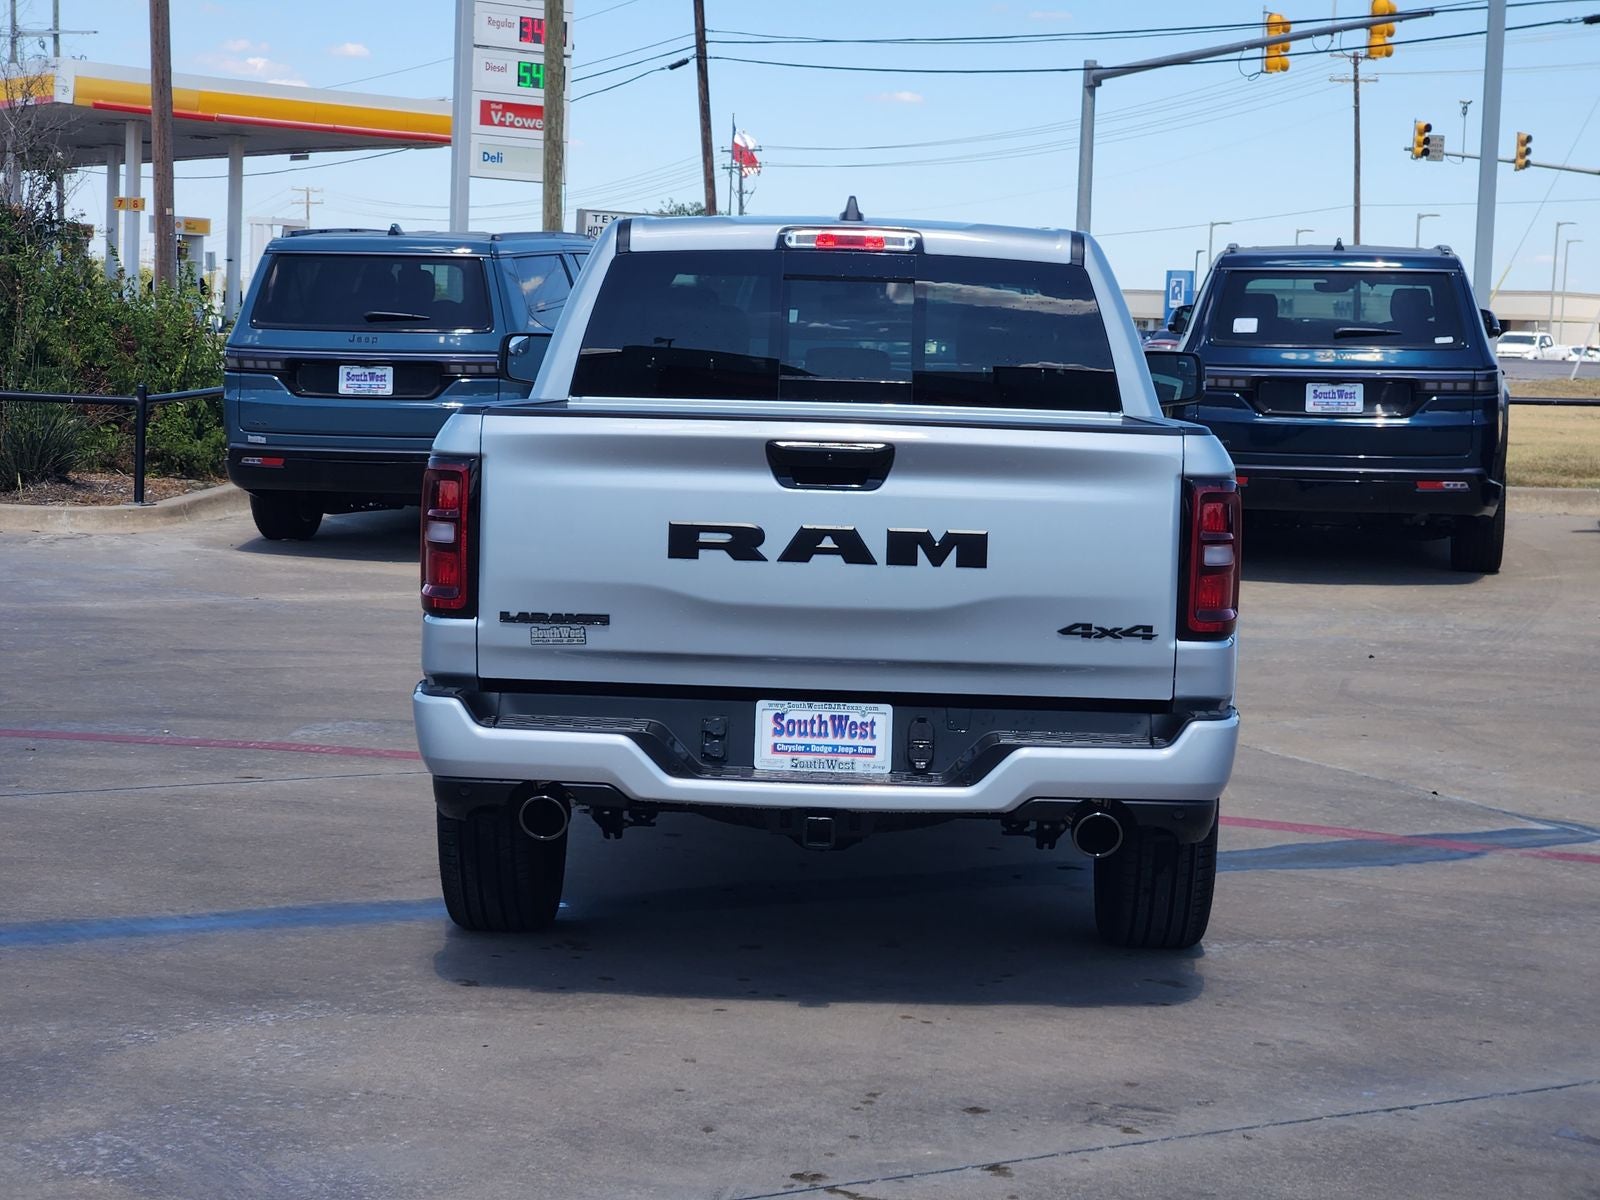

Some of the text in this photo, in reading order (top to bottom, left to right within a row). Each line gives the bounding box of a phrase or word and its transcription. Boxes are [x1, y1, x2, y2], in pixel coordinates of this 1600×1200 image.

[487, 16, 516, 30] Regular
[520, 16, 545, 44] 3.4
[485, 61, 508, 73] Diesel
[518, 61, 545, 89] 5.4
[491, 110, 545, 129] V-Powe
[482, 151, 503, 163] Deli
[118, 199, 123, 207] 7
[592, 214, 618, 224] TEX
[348, 334, 378, 344] Jeep
[346, 371, 386, 382] SouthWest
[1312, 389, 1356, 400] SouthWest
[668, 521, 988, 568] RAM
[531, 626, 585, 638] SouthWest
[771, 711, 877, 741] SouthWest
[776, 743, 805, 753] Chrysler
[811, 744, 832, 753] Dodge
[838, 745, 854, 755] Jeep
[790, 758, 856, 771] SouthWest
